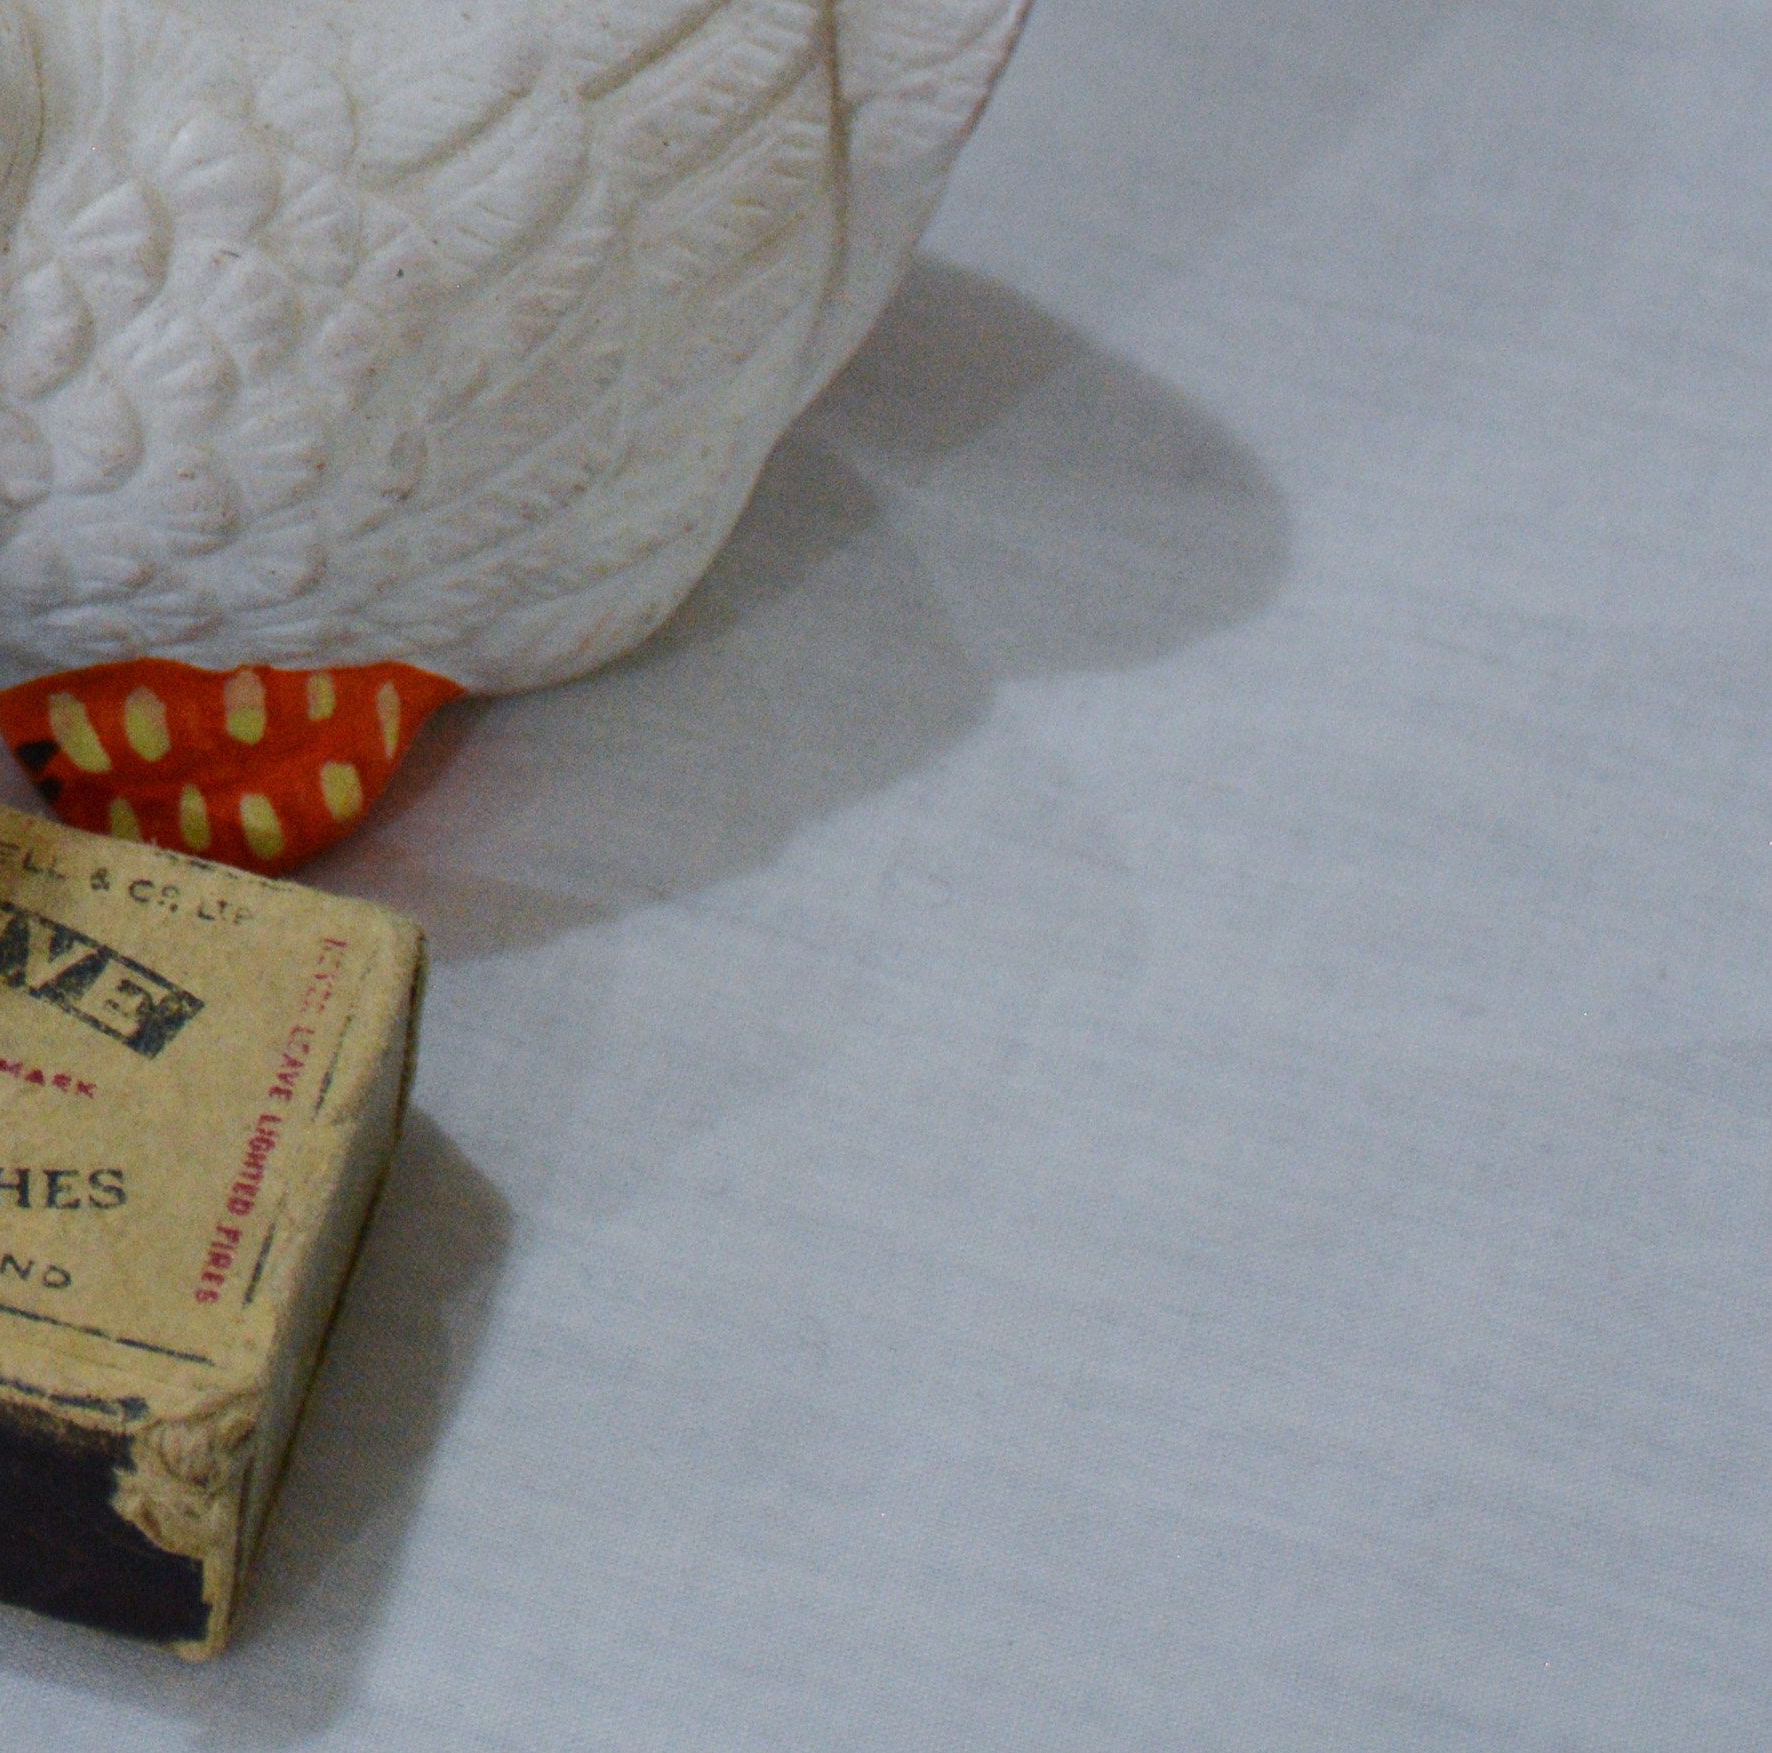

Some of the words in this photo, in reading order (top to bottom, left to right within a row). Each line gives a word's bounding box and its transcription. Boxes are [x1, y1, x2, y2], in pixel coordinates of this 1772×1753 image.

[89, 866, 111, 892] &
[268, 1023, 316, 1102] LEAVE
[226, 1113, 284, 1216] LIGHTED
[193, 1221, 243, 1305] FIRES
